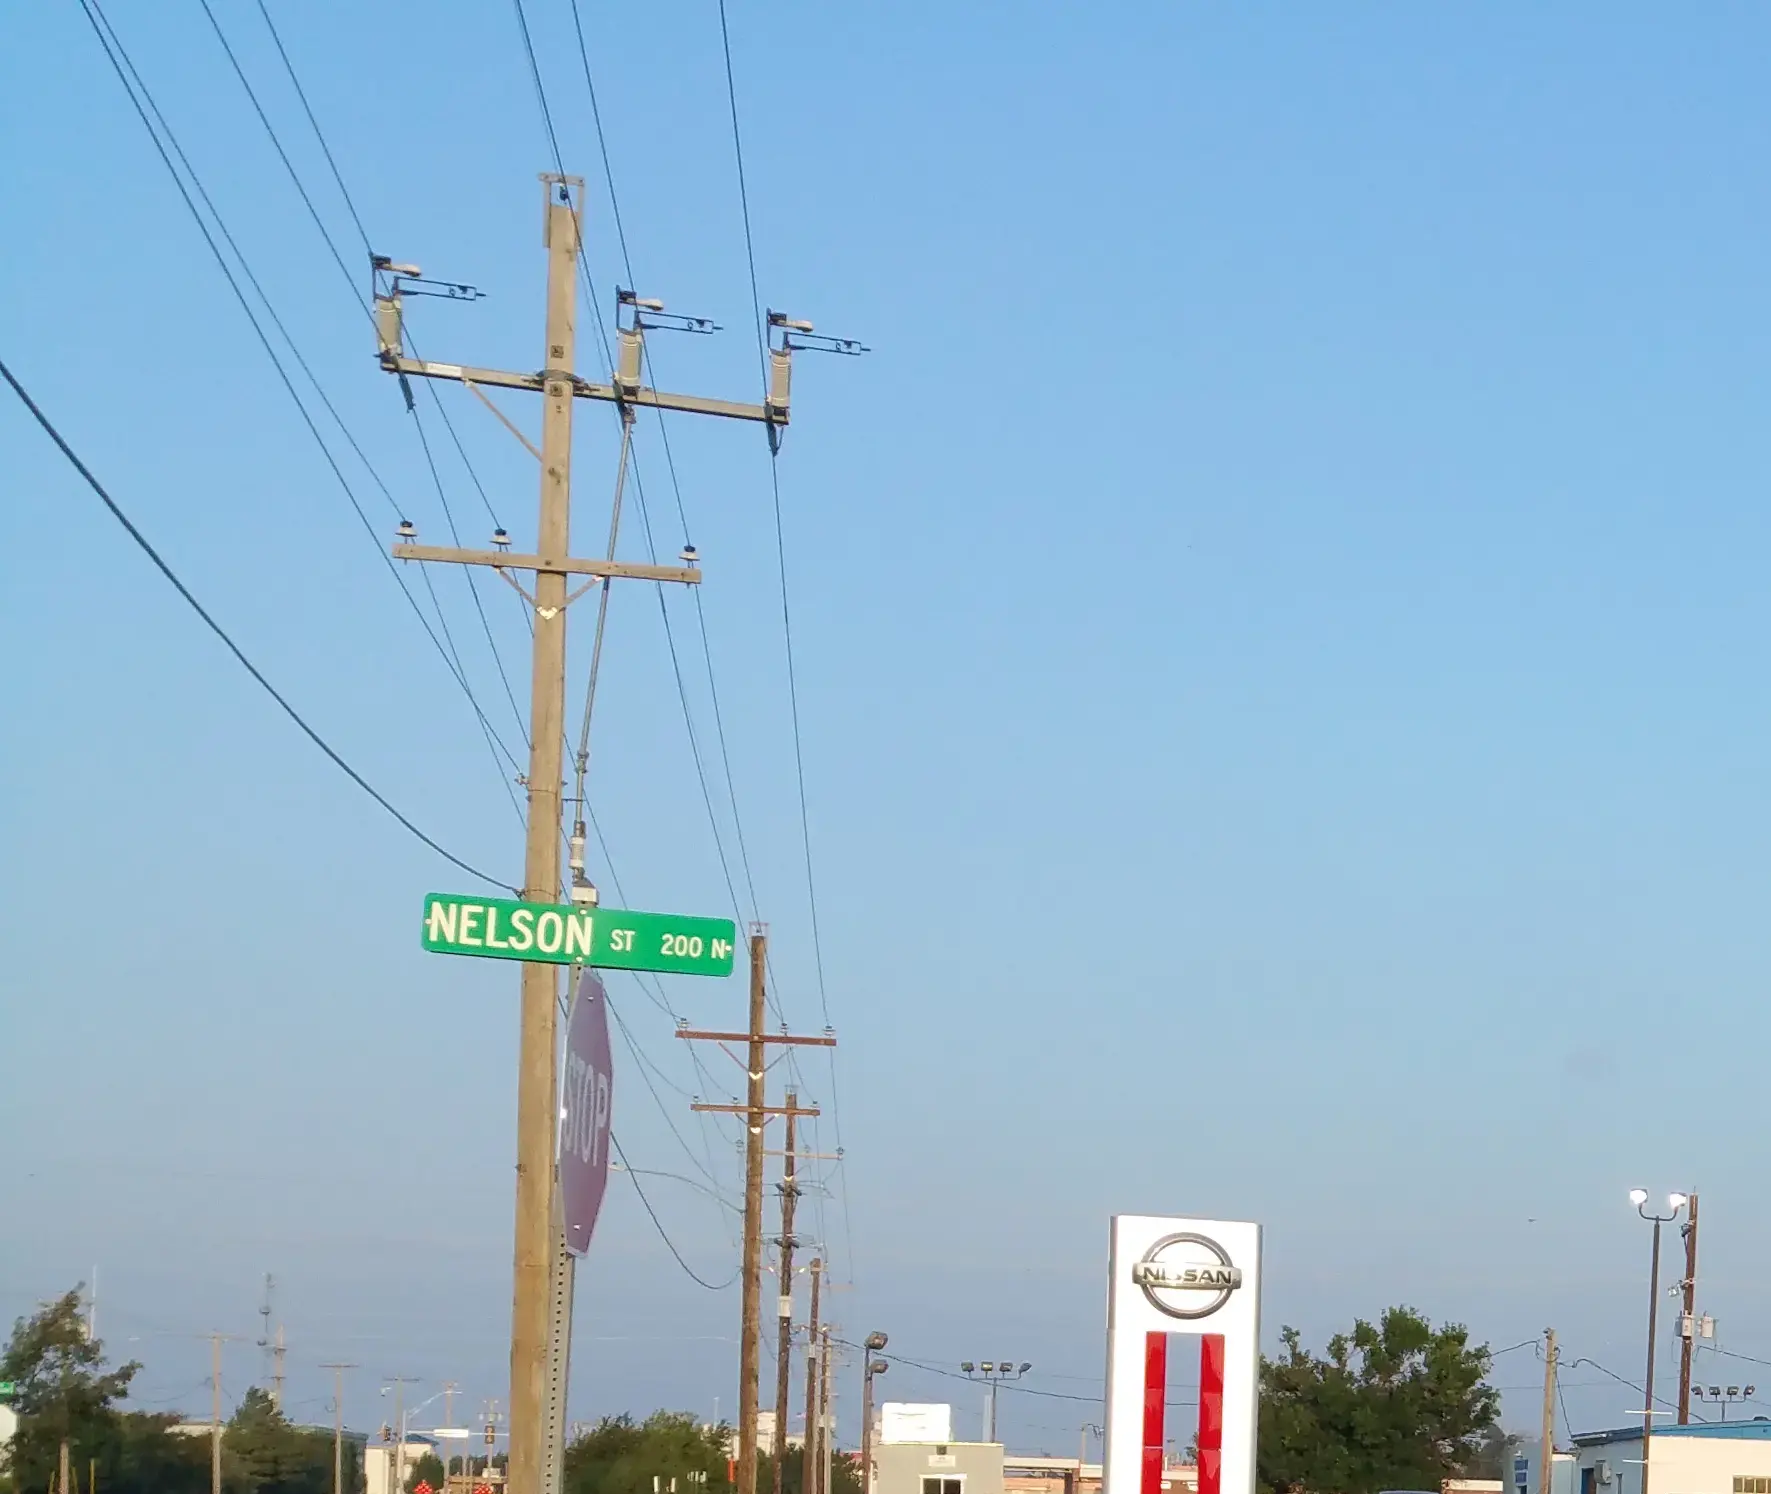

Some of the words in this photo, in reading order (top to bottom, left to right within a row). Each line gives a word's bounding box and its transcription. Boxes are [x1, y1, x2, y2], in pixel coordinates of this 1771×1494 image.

[429, 901, 593, 956] NELSON
[610, 929, 636, 952] ST
[660, 934, 702, 958] 200
[711, 938, 726, 960] N
[1143, 1266, 1232, 1284] NISAN
